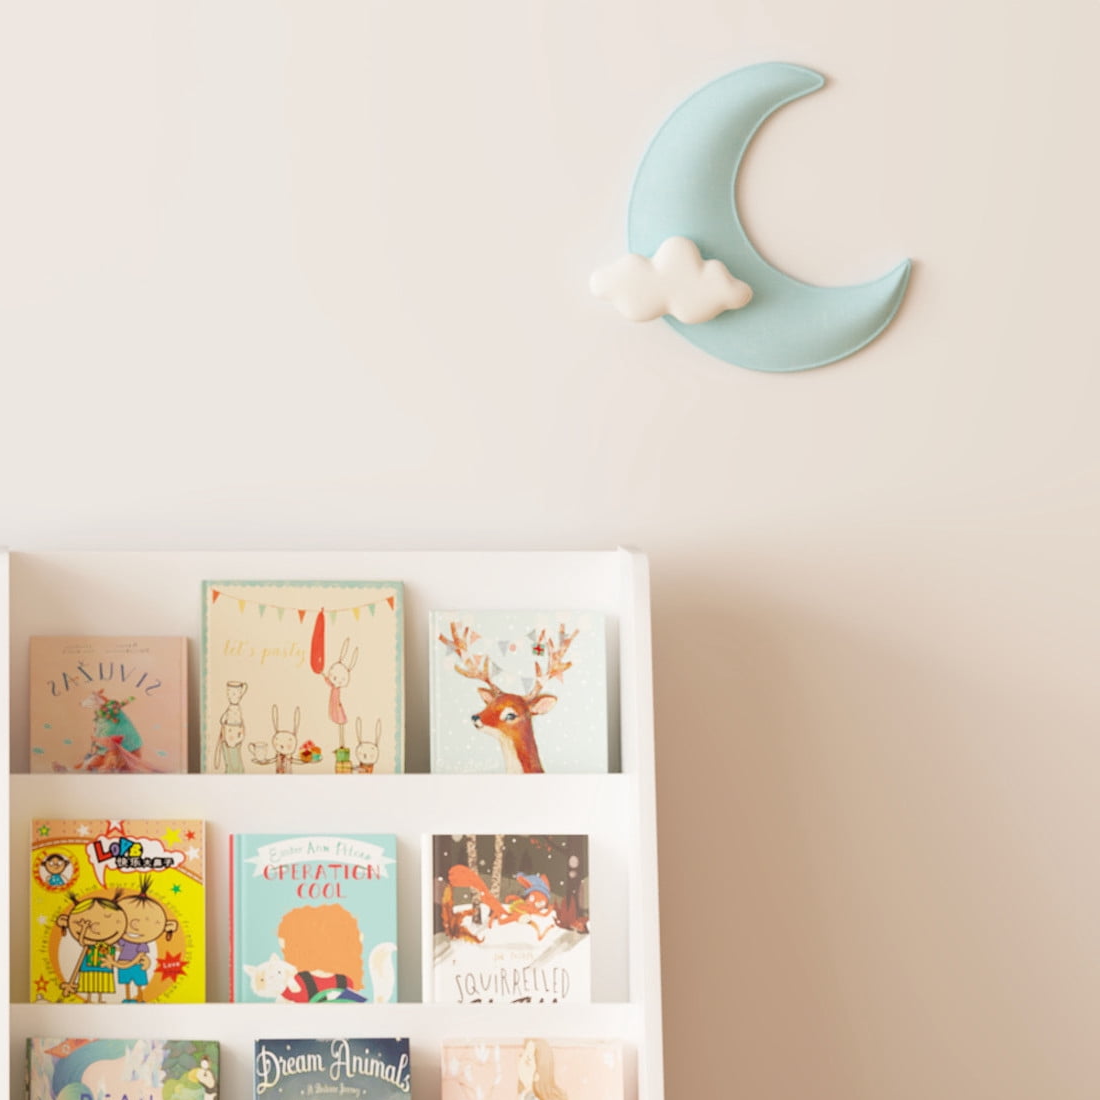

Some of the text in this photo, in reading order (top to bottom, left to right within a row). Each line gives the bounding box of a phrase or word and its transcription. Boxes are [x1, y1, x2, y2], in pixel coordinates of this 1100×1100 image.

[263, 864, 381, 881] OPERATION
[296, 882, 348, 899] COOL
[256, 1038, 411, 1096] Dream Animals
